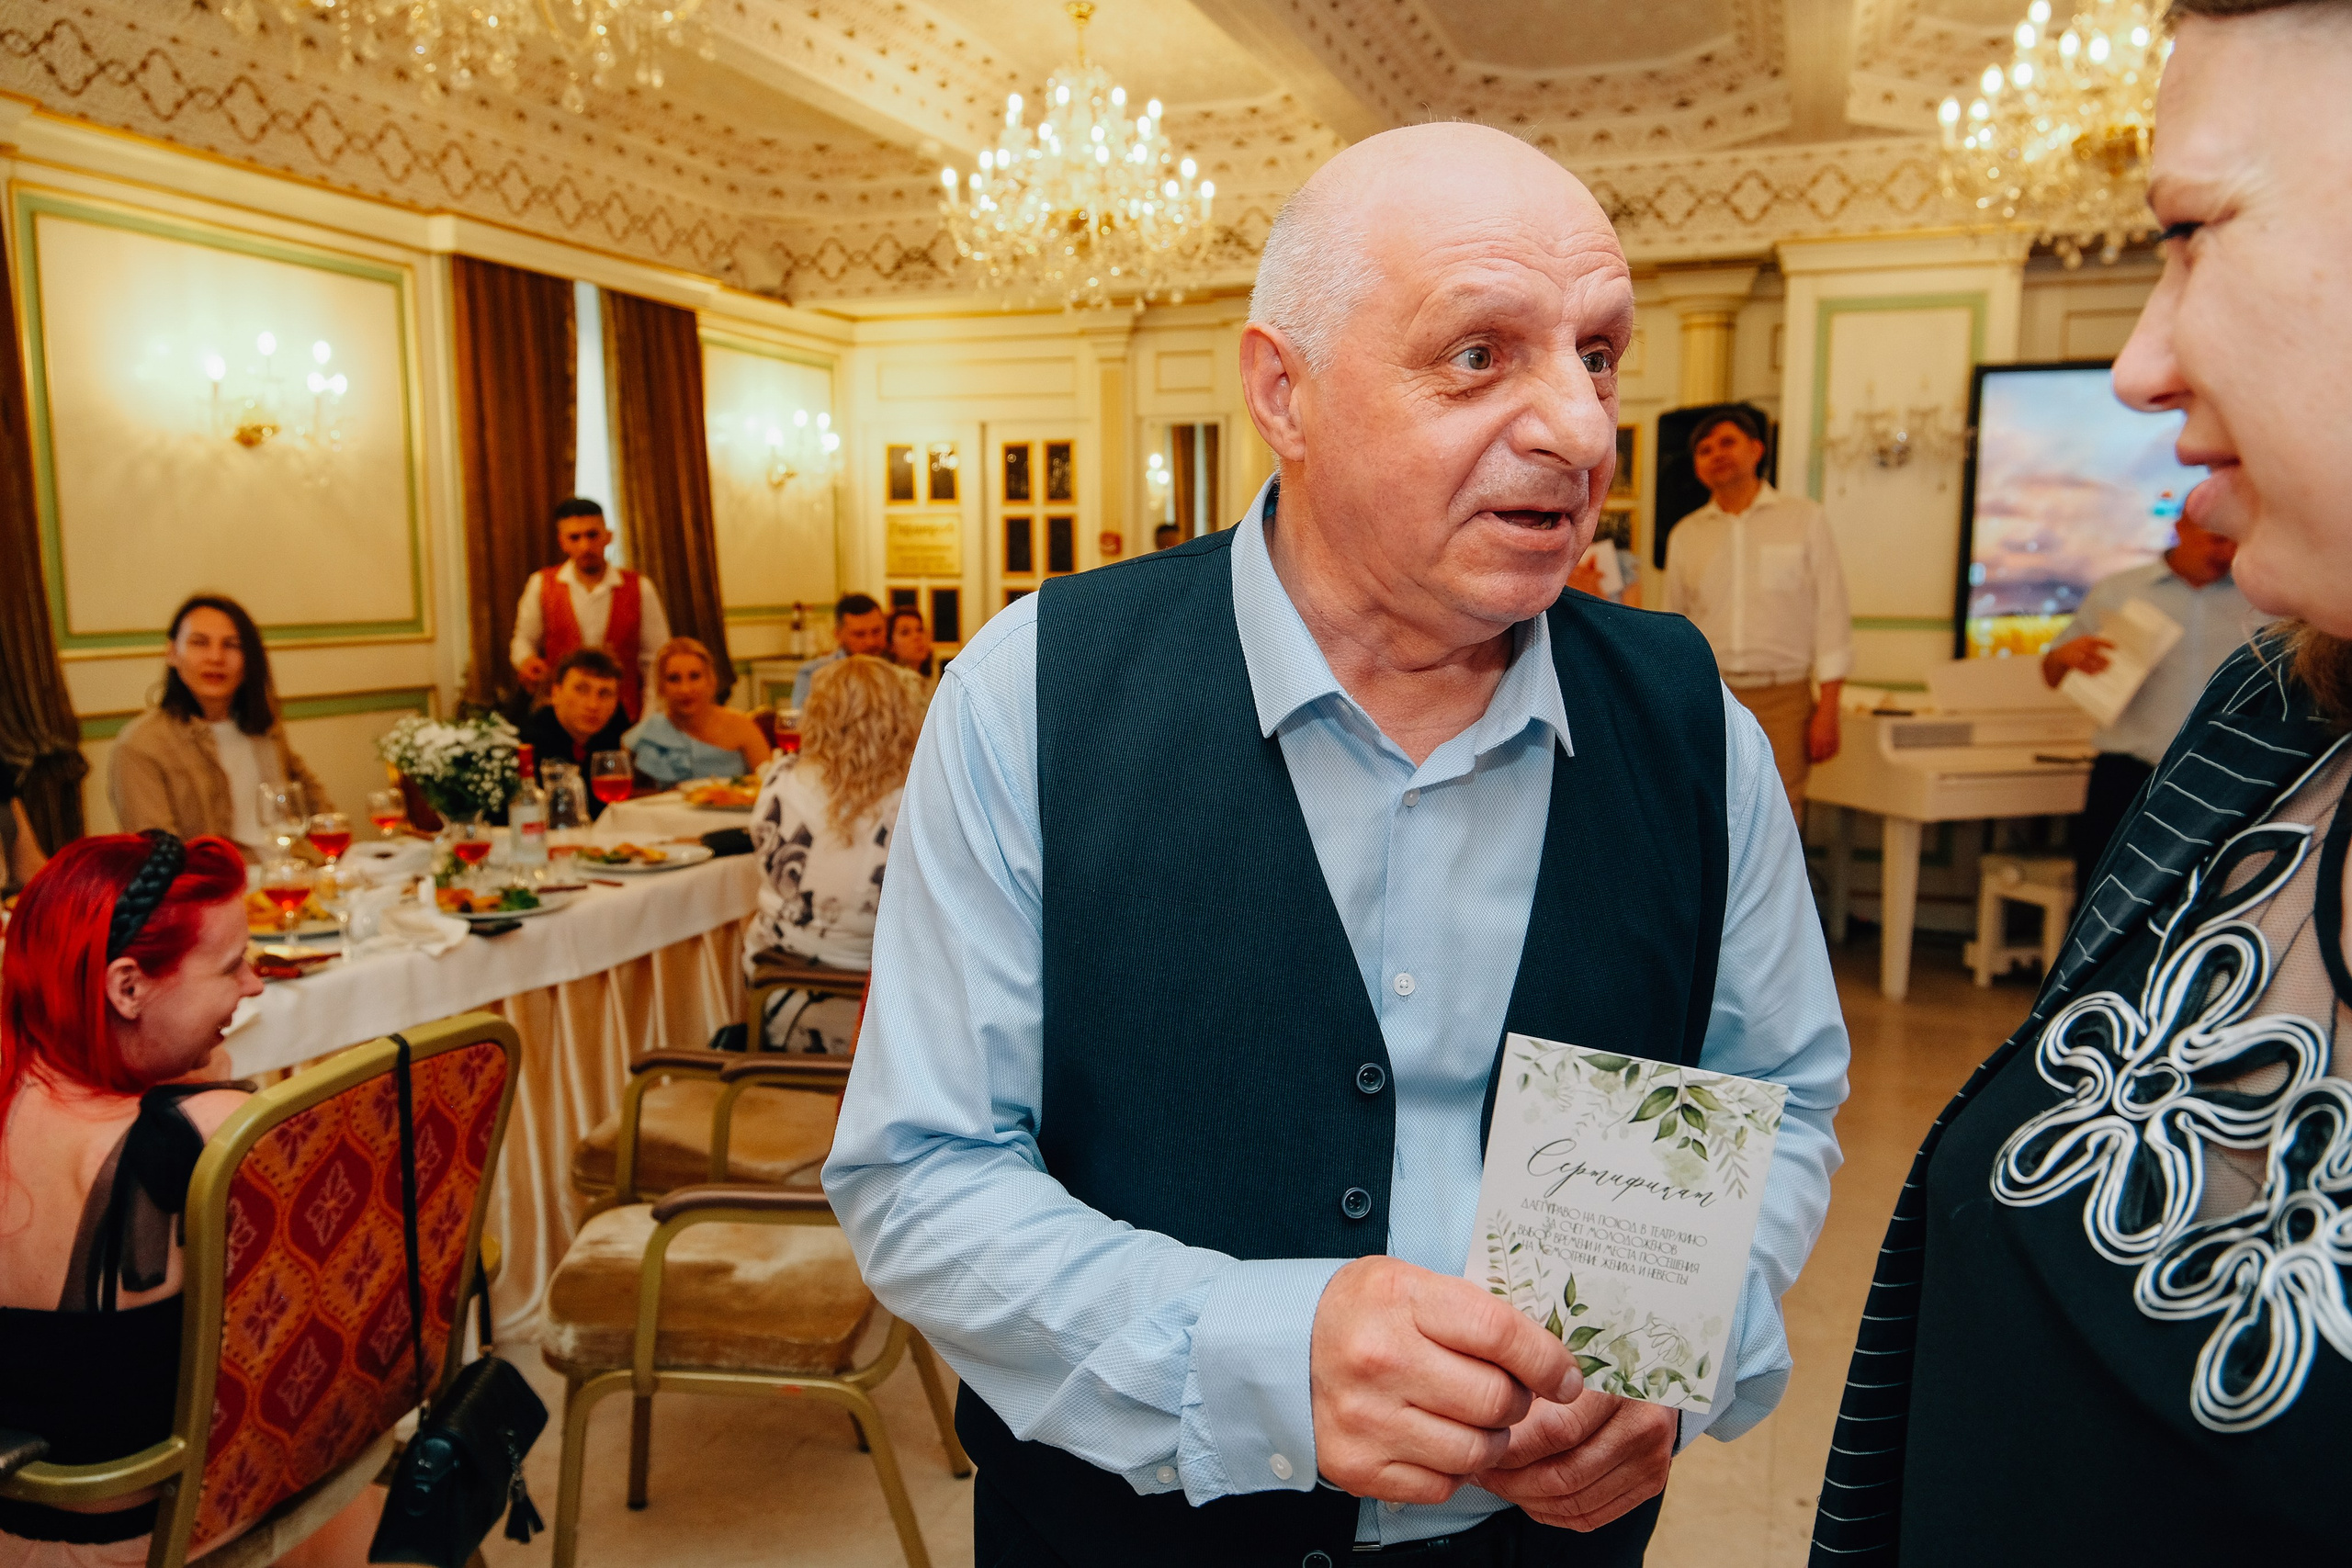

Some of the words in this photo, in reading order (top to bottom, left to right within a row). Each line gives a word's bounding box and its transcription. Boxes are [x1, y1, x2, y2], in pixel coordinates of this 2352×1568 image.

[1527, 1138, 1716, 1207] Сертификат
[1517, 1224, 1552, 1240] ВЫБОР
[1554, 1233, 1592, 1250] ВРЕМЕНИ
[1594, 1242, 1601, 1253] И
[1603, 1244, 1636, 1261] МЕСТА
[1521, 1198, 1545, 1212] ДАЕТ
[1549, 1203, 1581, 1220] ПРАВО
[1583, 1212, 1595, 1224] НА
[1599, 1214, 1636, 1234] ПОХОД
[1641, 1224, 1647, 1235] В
[1651, 1225, 1708, 1247] ТЕАТР/КИНО
[1543, 1216, 1556, 1228] ЗА
[1560, 1221, 1584, 1234] СЧЕТ
[1587, 1227, 1678, 1255] МОЛОДОЖЕНОВ
[1522, 1239, 1534, 1251] НА
[1600, 1258, 1635, 1274] ЖЕНИХА
[1638, 1266, 1646, 1276] И
[1647, 1268, 1690, 1285] НЕВЕСТЫ
